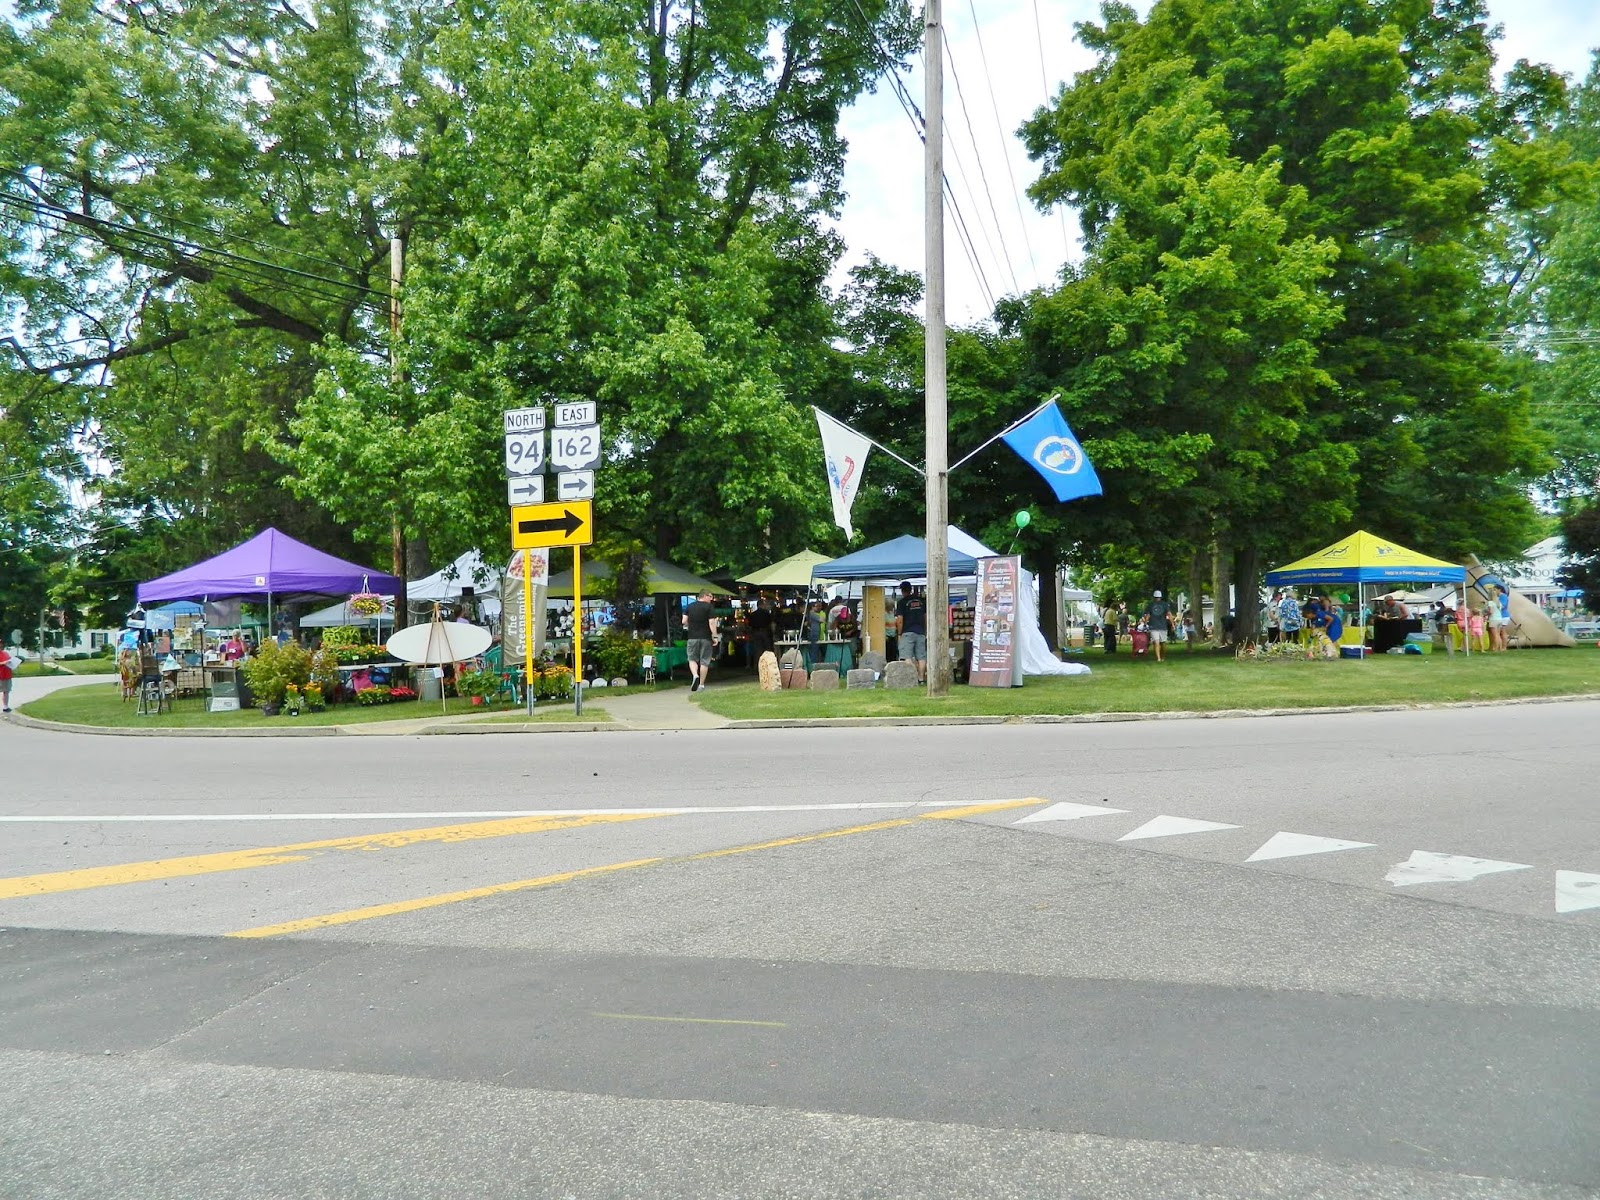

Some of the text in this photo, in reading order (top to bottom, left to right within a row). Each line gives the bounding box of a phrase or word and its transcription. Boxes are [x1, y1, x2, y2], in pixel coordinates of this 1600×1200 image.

[507, 413, 542, 428] NORTH
[562, 407, 588, 421] EAST
[509, 440, 540, 464] 94
[557, 436, 592, 458] 162
[508, 615, 517, 636] The
[515, 589, 527, 657] Greensmith
[971, 561, 985, 672] www.BoulderDesigns.net
